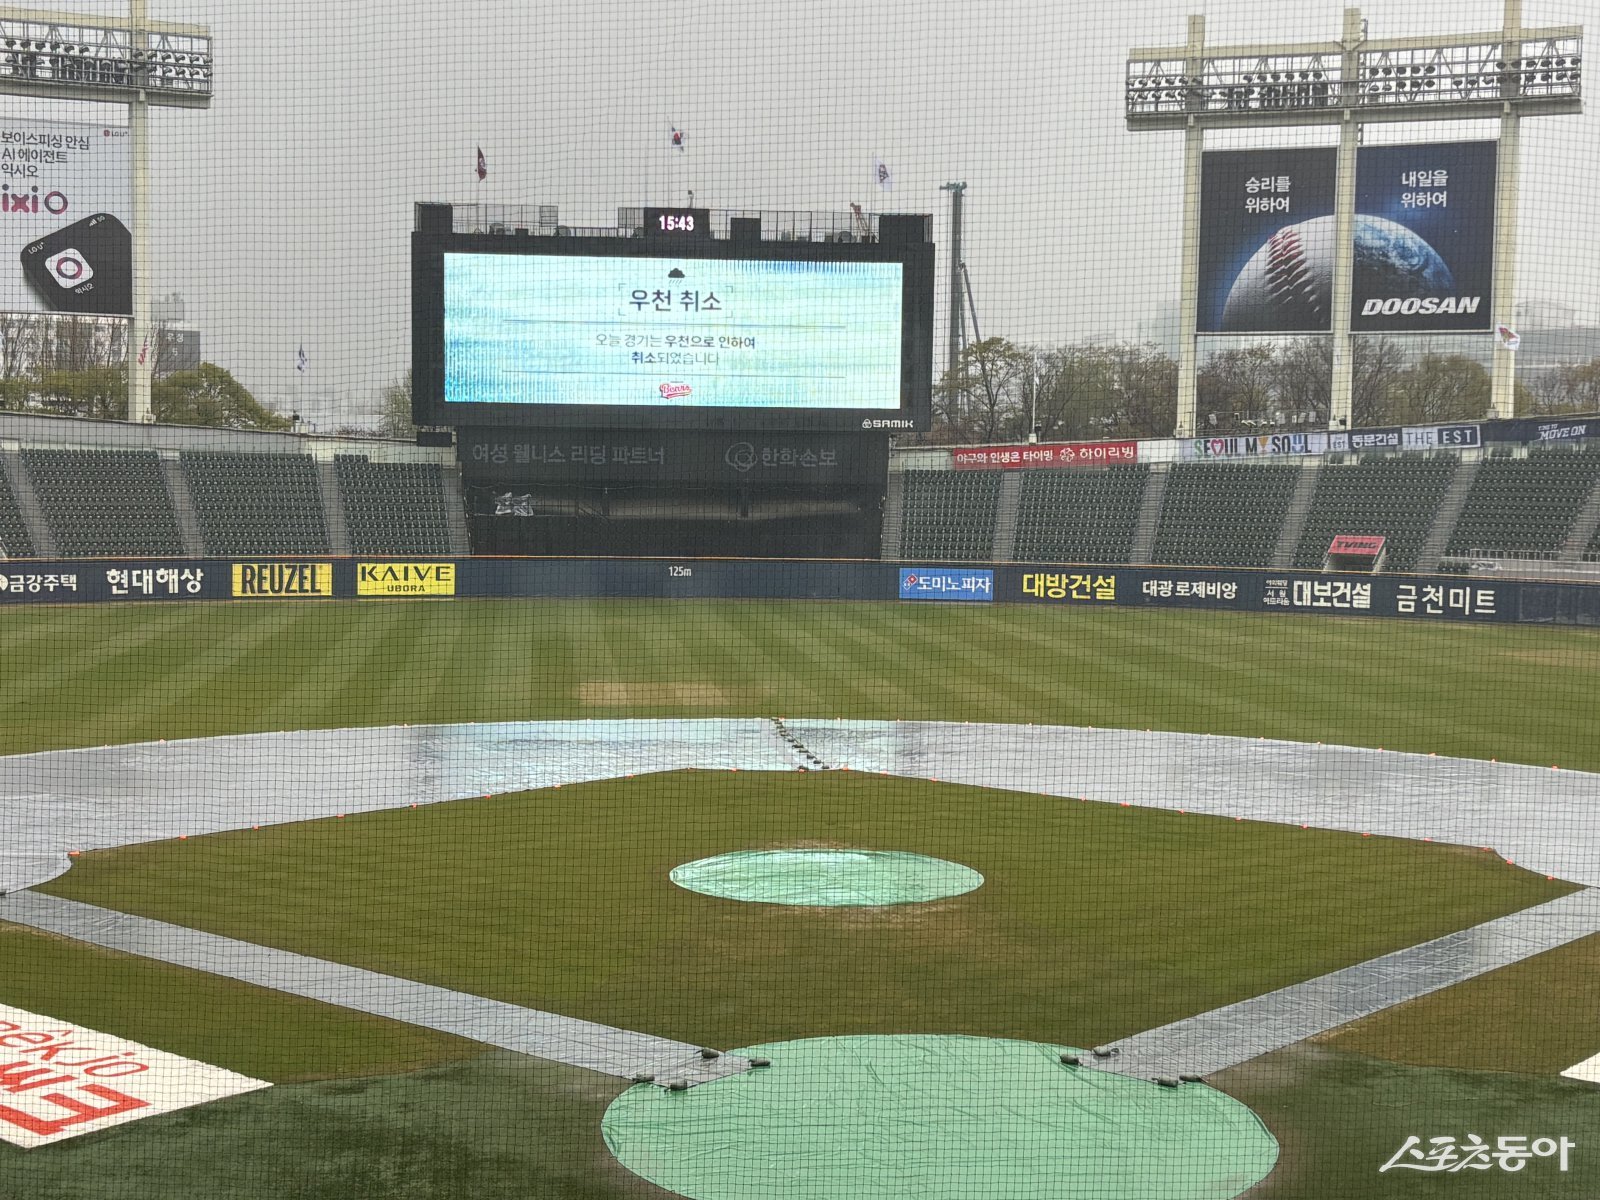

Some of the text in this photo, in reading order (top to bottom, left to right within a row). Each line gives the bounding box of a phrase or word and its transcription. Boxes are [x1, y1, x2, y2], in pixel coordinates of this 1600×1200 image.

[1, 131, 90, 150] 보이스피싱 안심
[1, 148, 68, 163] AI 에이전트
[1, 163, 39, 178] 익시오
[1401, 170, 1449, 187] 내일을
[1245, 176, 1291, 193] 승리를
[1245, 196, 1290, 213] 위하여
[1401, 191, 1447, 208] 위하여
[659, 215, 694, 231] 15:43
[629, 289, 722, 312] 우천 취소
[1361, 296, 1480, 315] DOOSAN
[596, 334, 755, 349] 오늘 경기는 우천으로 인하여
[631, 351, 719, 365] 취소되었습니다
[872, 419, 914, 428] SAMIK
[1352, 433, 1399, 448] 동문건설
[1442, 429, 1473, 444] EST
[1539, 425, 1587, 440] MOVE ON
[1079, 446, 1134, 460] 하이리빙
[1271, 435, 1312, 454] SOUL
[473, 443, 664, 465] 여성 웰니스 리딩 파트너
[762, 447, 838, 467] 한화손보
[956, 449, 1054, 464] 야구와 인생은 타이밍
[241, 564, 321, 594] REUZEL
[361, 566, 451, 581] KAIVE
[668, 566, 692, 577] 125m
[10, 574, 77, 593] 금강주택
[106, 568, 205, 595] 현대해상
[917, 576, 991, 593] 도미노피자
[1022, 573, 1116, 600] 대방건설
[1142, 580, 1238, 599] 대광 로제비앙
[1293, 580, 1371, 609] 대보건설
[1396, 584, 1496, 615] 금천미트
